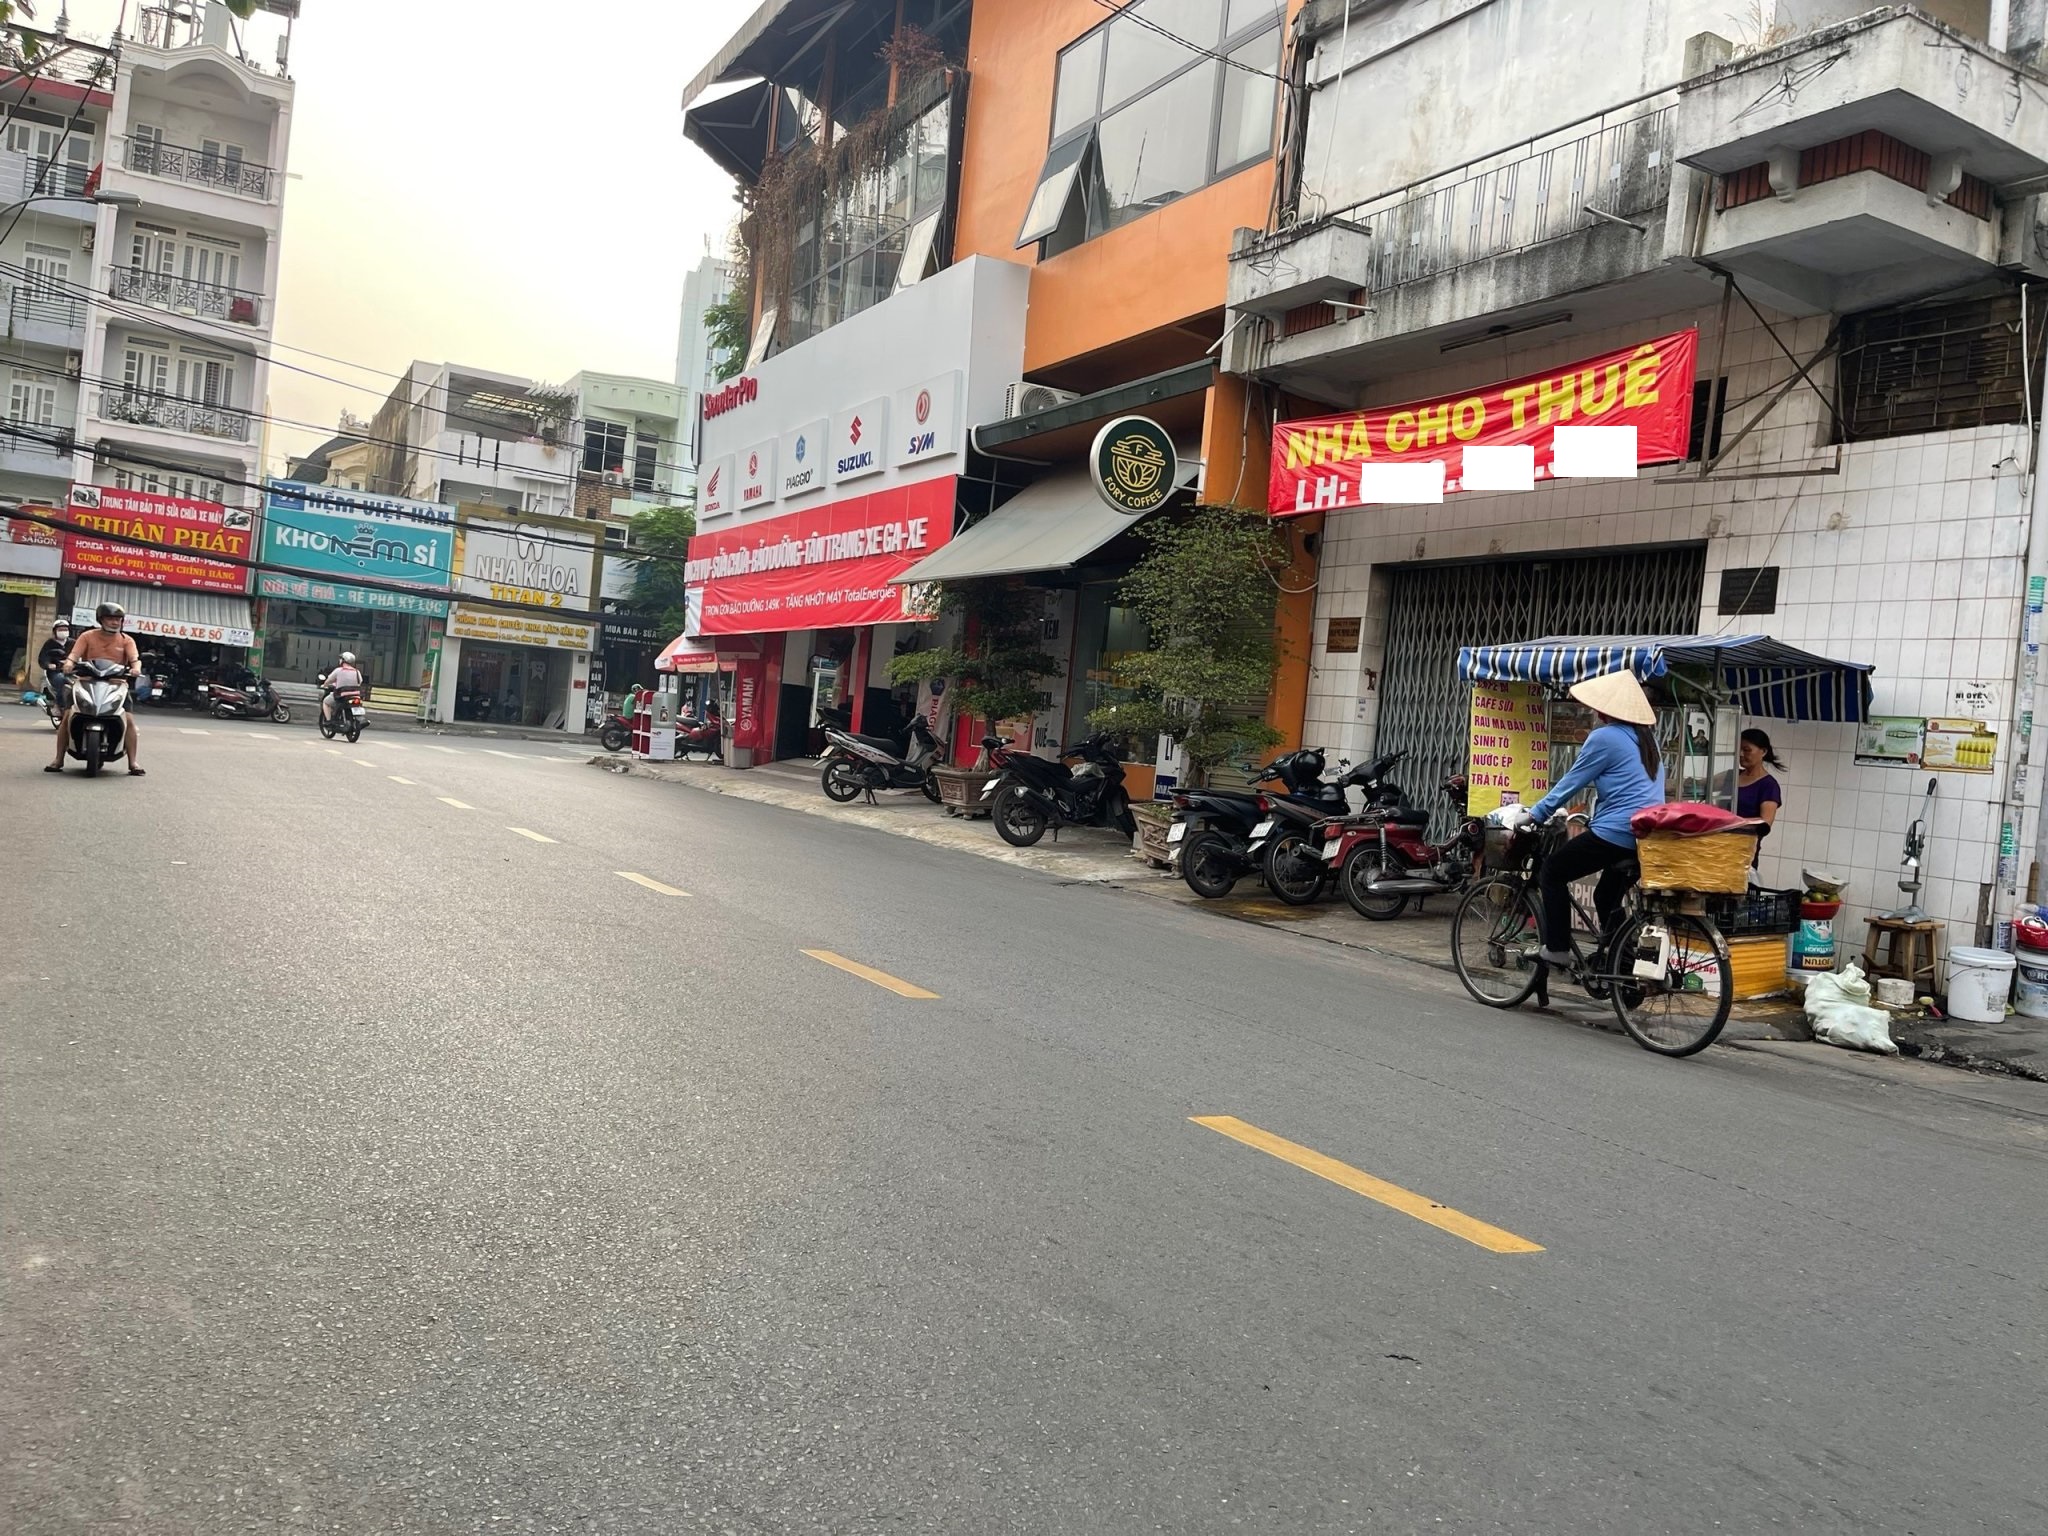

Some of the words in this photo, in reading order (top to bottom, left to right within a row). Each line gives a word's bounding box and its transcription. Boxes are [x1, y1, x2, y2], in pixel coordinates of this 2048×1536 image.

[1286, 410, 1373, 469] NHÀ
[1384, 397, 1486, 453] CHO
[1502, 343, 1662, 430] THUÊ
[908, 431, 935, 455] SYM
[837, 451, 872, 475] SUZUKI
[786, 472, 811, 490] PIAGGIO
[1104, 477, 1126, 501] FORY
[1127, 488, 1163, 508] COFFEE
[1294, 474, 1347, 511] LH:
[174, 527, 244, 554] PHÁT
[276, 526, 328, 551] KHO
[865, 525, 884, 556] XE
[883, 521, 902, 553] GA
[906, 517, 929, 550] XE
[75, 540, 104, 551] HONDA
[111, 544, 144, 557] YAMAHA
[149, 551, 167, 560] SYM
[77, 553, 103, 564] CUNG
[475, 554, 518, 585] NHA
[523, 561, 579, 595] KHOA
[490, 583, 546, 607] TITAN
[550, 594, 564, 609] 2
[844, 585, 897, 602] TotalEnergies
[136, 620, 159, 632] TAY
[161, 623, 177, 635] GA
[190, 627, 205, 639] XE
[741, 677, 754, 718] YAMAHA
[1475, 696, 1497, 710] CAFE
[1474, 715, 1490, 728] RAU
[1529, 722, 1547, 733] 10K
[1473, 734, 1496, 748] SINH
[1531, 740, 1548, 752] 20K
[1472, 753, 1499, 766] NƯỚC
[1501, 754, 1513, 768] ÉP
[1531, 759, 1548, 771] 20K
[1531, 778, 1548, 790] 10K
